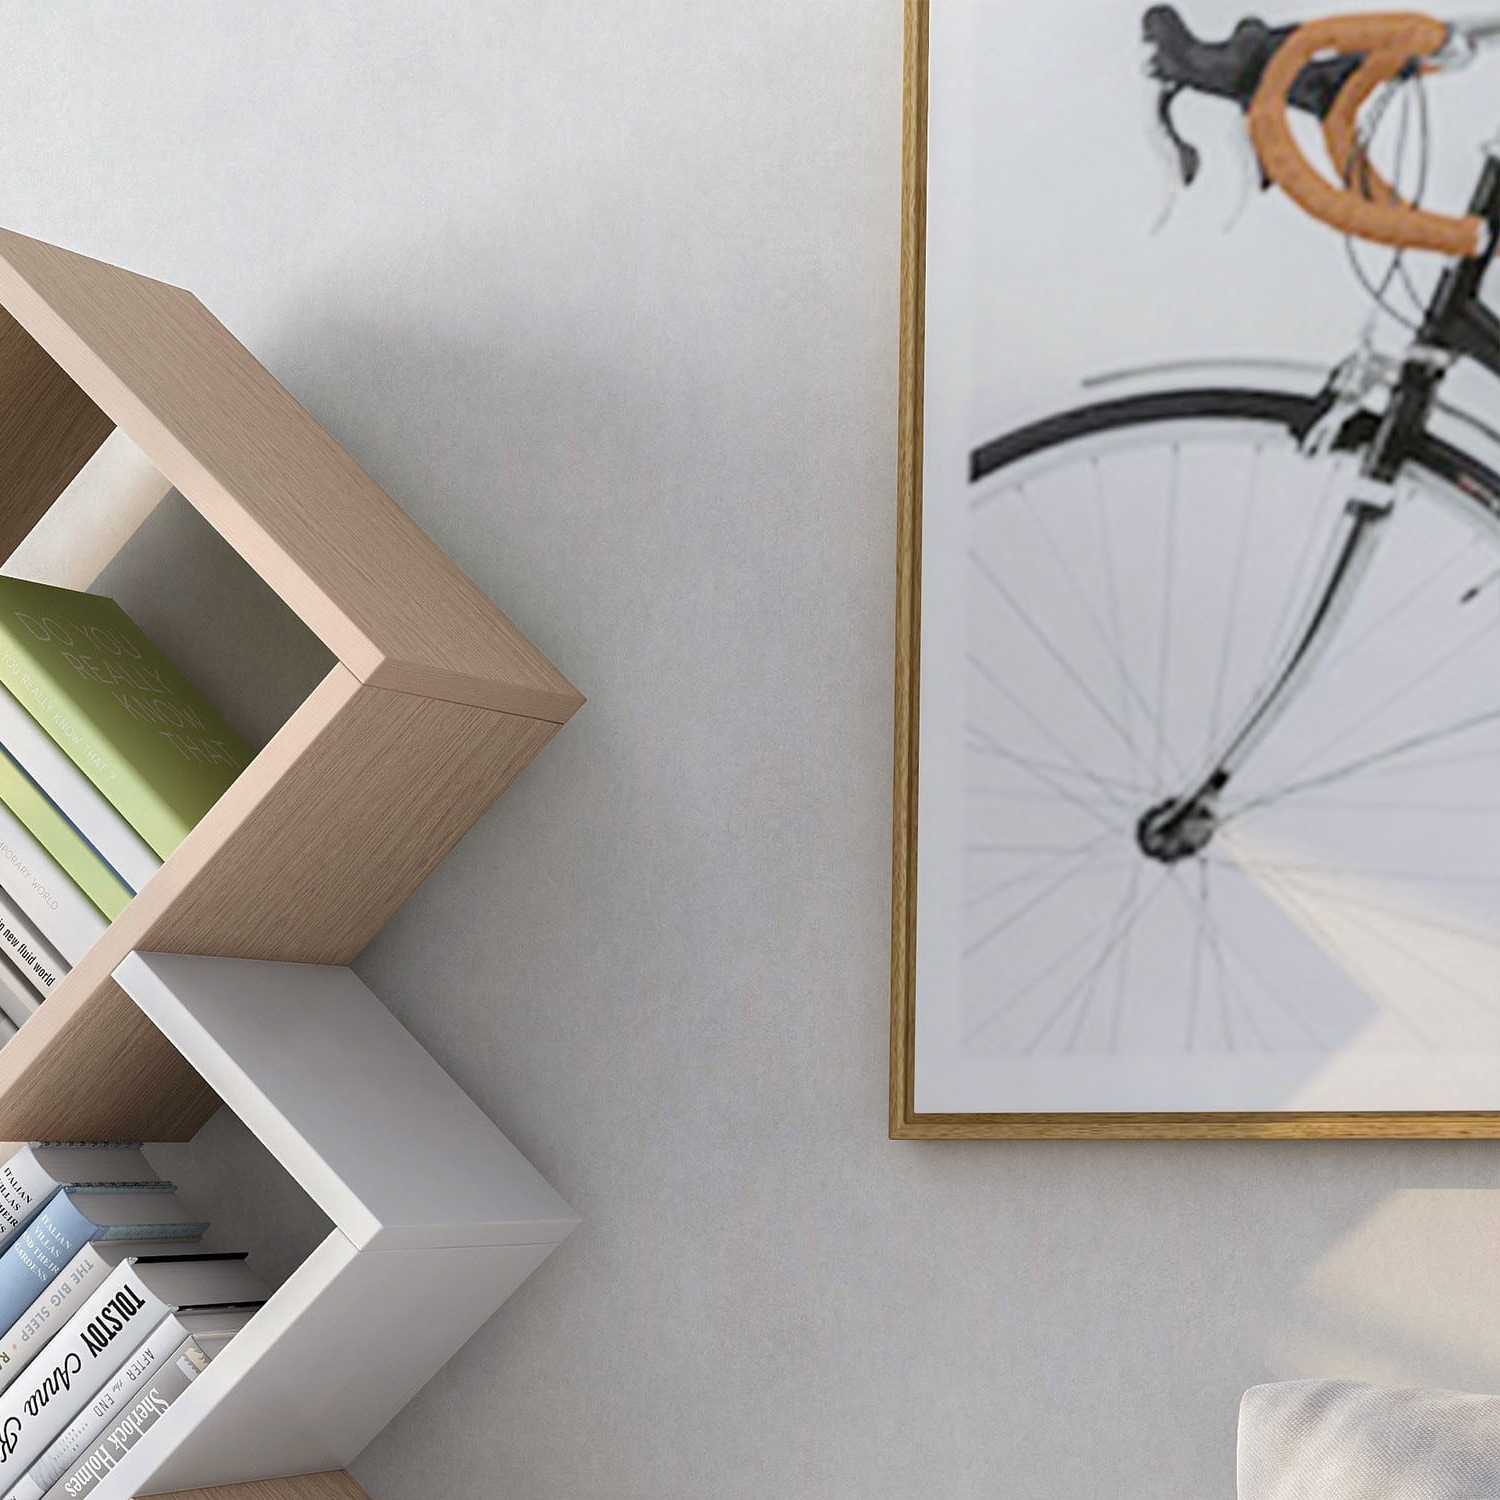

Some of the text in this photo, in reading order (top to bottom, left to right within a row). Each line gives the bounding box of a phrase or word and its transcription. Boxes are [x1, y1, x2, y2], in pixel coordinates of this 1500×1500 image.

[15, 612, 141, 658] DO YOU
[63, 652, 172, 694] REALLY
[3, 651, 22, 675] YOU
[21, 675, 53, 711] REALLY
[52, 711, 83, 745] KNOW
[83, 743, 107, 770] THAT
[113, 691, 206, 731] KNOW
[160, 731, 240, 768] THAT
[32, 878, 58, 910] WORLD
[4, 928, 18, 946] new
[17, 943, 35, 965] fluid
[33, 962, 55, 986] world
[4, 1168, 32, 1204] ITALIAN
[34, 1226, 60, 1258] VILLAS
[41, 1215, 71, 1249] ITALIAN
[15, 1243, 49, 1281] GARDENS
[34, 1247, 59, 1274] THEIR
[71, 1259, 93, 1285] THE
[51, 1285, 72, 1307] BIG
[21, 1307, 50, 1342] SLEEP
[80, 1284, 146, 1358] TOLSTOY
[126, 1348, 155, 1381] AFTER
[23, 1352, 82, 1416] Anna
[93, 1392, 115, 1417] END
[110, 1387, 169, 1453] Sherlock
[64, 1445, 117, 1497] Holmes
